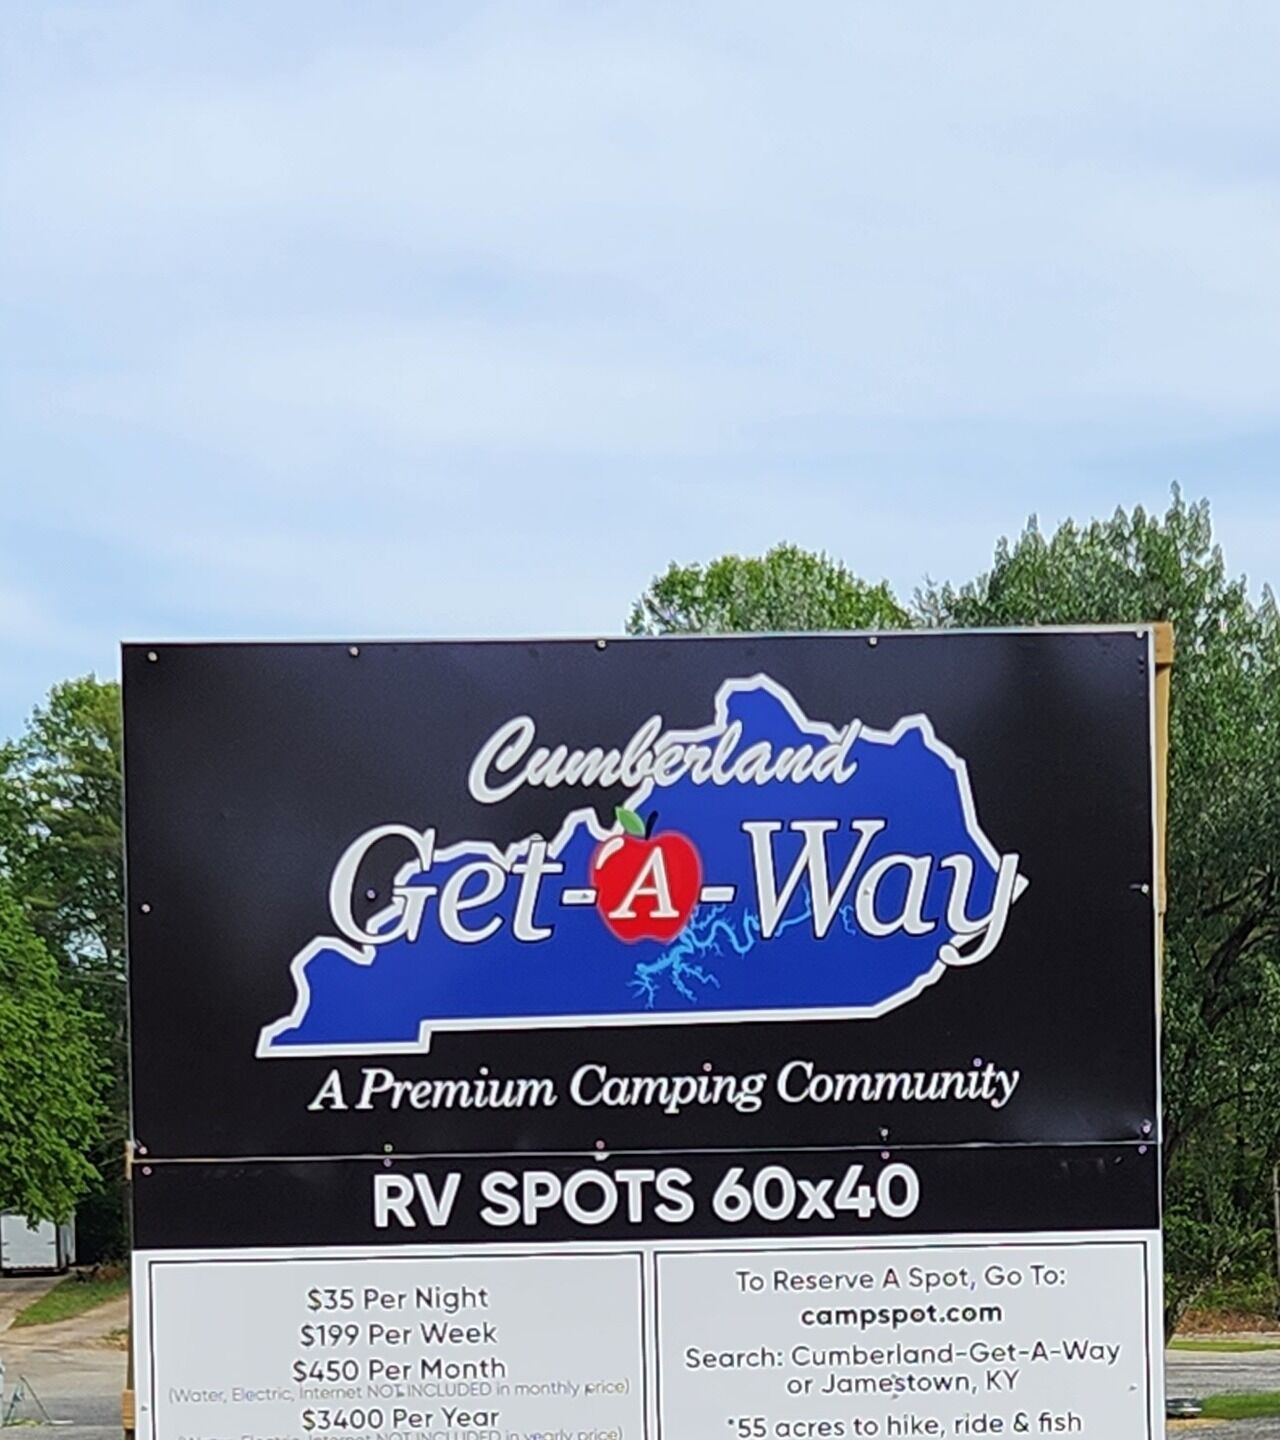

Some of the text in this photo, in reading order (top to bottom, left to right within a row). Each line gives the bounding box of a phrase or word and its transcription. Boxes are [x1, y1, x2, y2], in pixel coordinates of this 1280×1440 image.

[469, 714, 862, 804] Cumberland
[308, 1058, 1019, 1114] A Premium Camping Community
[374, 1163, 919, 1227] RV SPOTS 60x40
[736, 1265, 1064, 1293] To Reserve A Spot, Go To:
[308, 1287, 488, 1314] $35 Per Night
[802, 1305, 1001, 1330] campspot.com
[301, 1322, 496, 1347] $199 Per Week
[686, 1340, 1120, 1368] Search: Cumberland-Get-A-Way
[293, 1358, 505, 1382] $450 Per Month
[787, 1370, 1019, 1394] or Jamestown, KY
[232, 1387, 295, 1402] Electric,
[300, 1387, 362, 1399] Internet
[367, 1384, 405, 1398] NOT
[407, 1382, 492, 1397] INCLUDED
[497, 1382, 510, 1395] in
[515, 1380, 580, 1397] monthly
[585, 1378, 629, 1396] price)
[303, 1408, 499, 1431] $3400 Per Year
[776, 1422, 844, 1437] acres
[854, 1419, 878, 1435] to
[888, 1415, 944, 1437] hike,
[956, 1413, 1003, 1433] ride
[1014, 1412, 1029, 1432] &
[1039, 1412, 1081, 1432] fish
